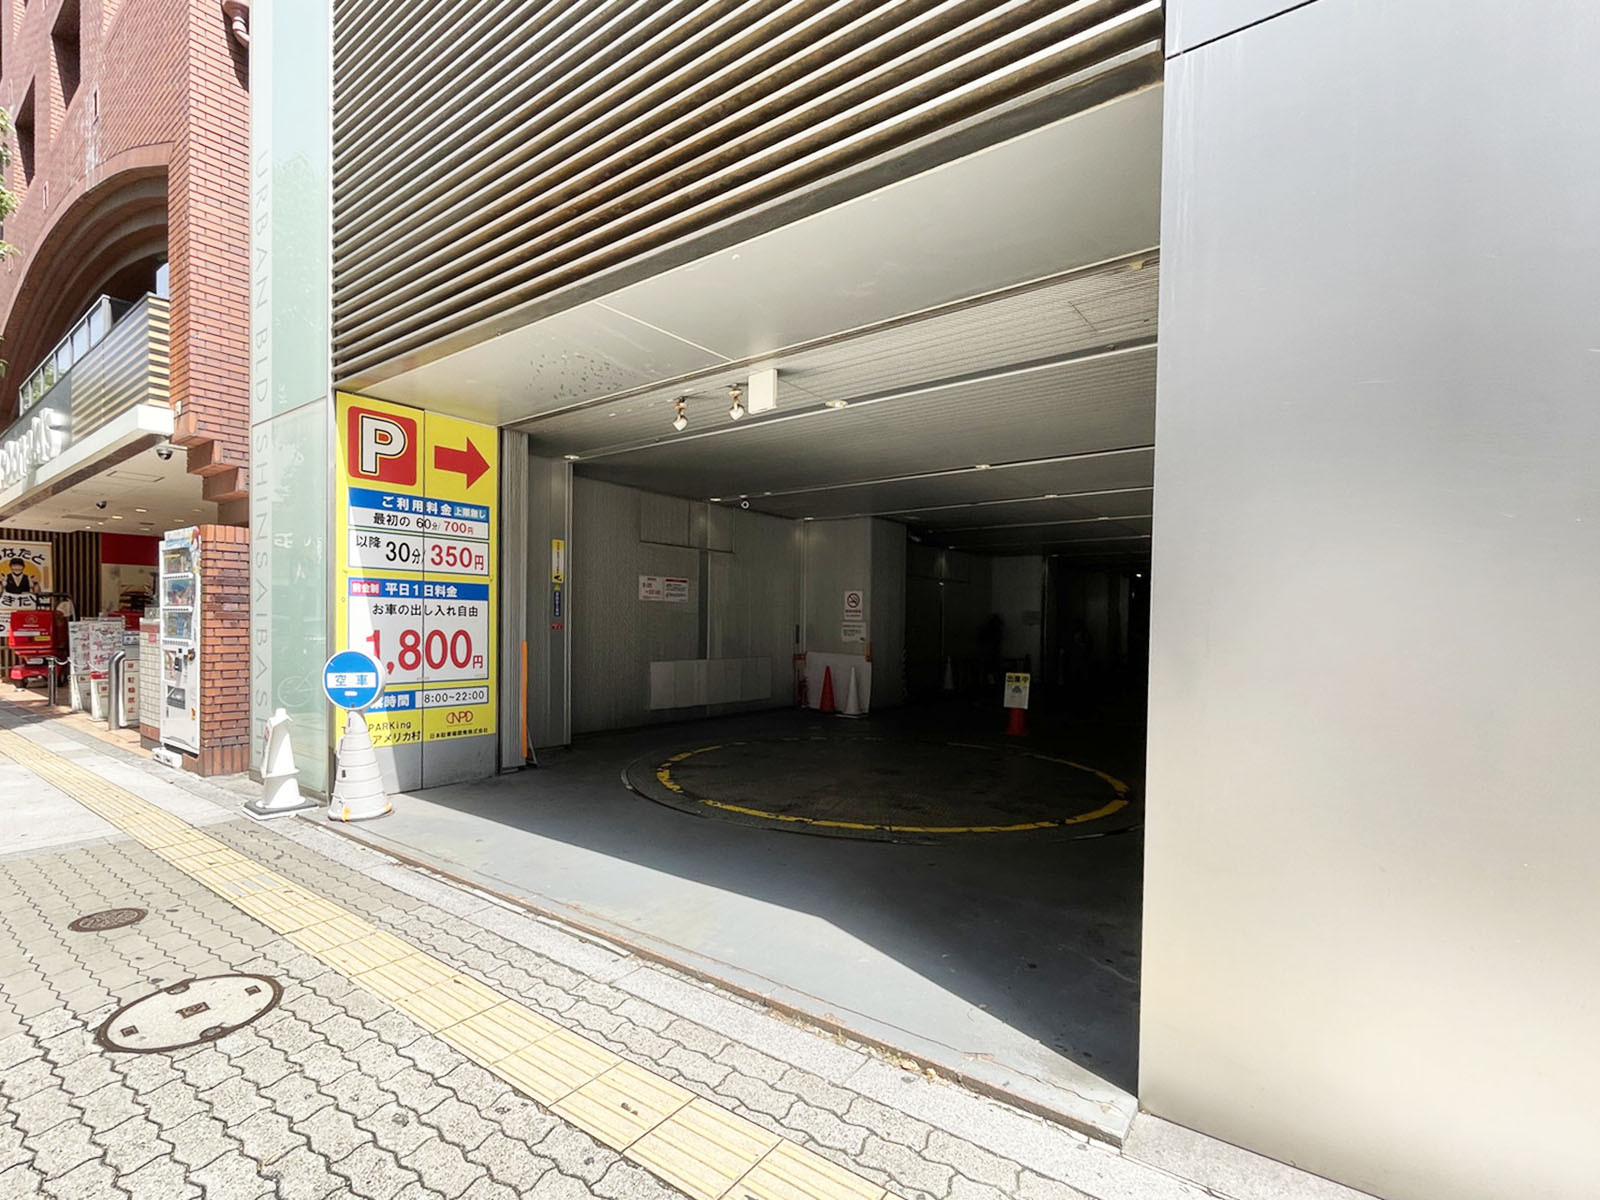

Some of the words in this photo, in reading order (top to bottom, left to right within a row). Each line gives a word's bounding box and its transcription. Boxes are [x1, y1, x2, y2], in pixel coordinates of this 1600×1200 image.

[255, 149, 268, 310] URBAN
[255, 327, 268, 402] BLD
[360, 415, 407, 475] P
[381, 496, 453, 516] ご利用料金
[373, 512, 411, 527] 最初の
[443, 520, 474, 535] 700円
[0, 548, 45, 565] なたと
[356, 535, 381, 549] 以降
[430, 544, 484, 571] 350円
[385, 582, 458, 598] 平日1日料金
[372, 603, 479, 618] お車の出し入れ自由
[366, 629, 484, 675] 1,800円
[370, 693, 410, 709] 時間
[368, 719, 412, 732] PARKing
[373, 730, 421, 745] アメリカ村
